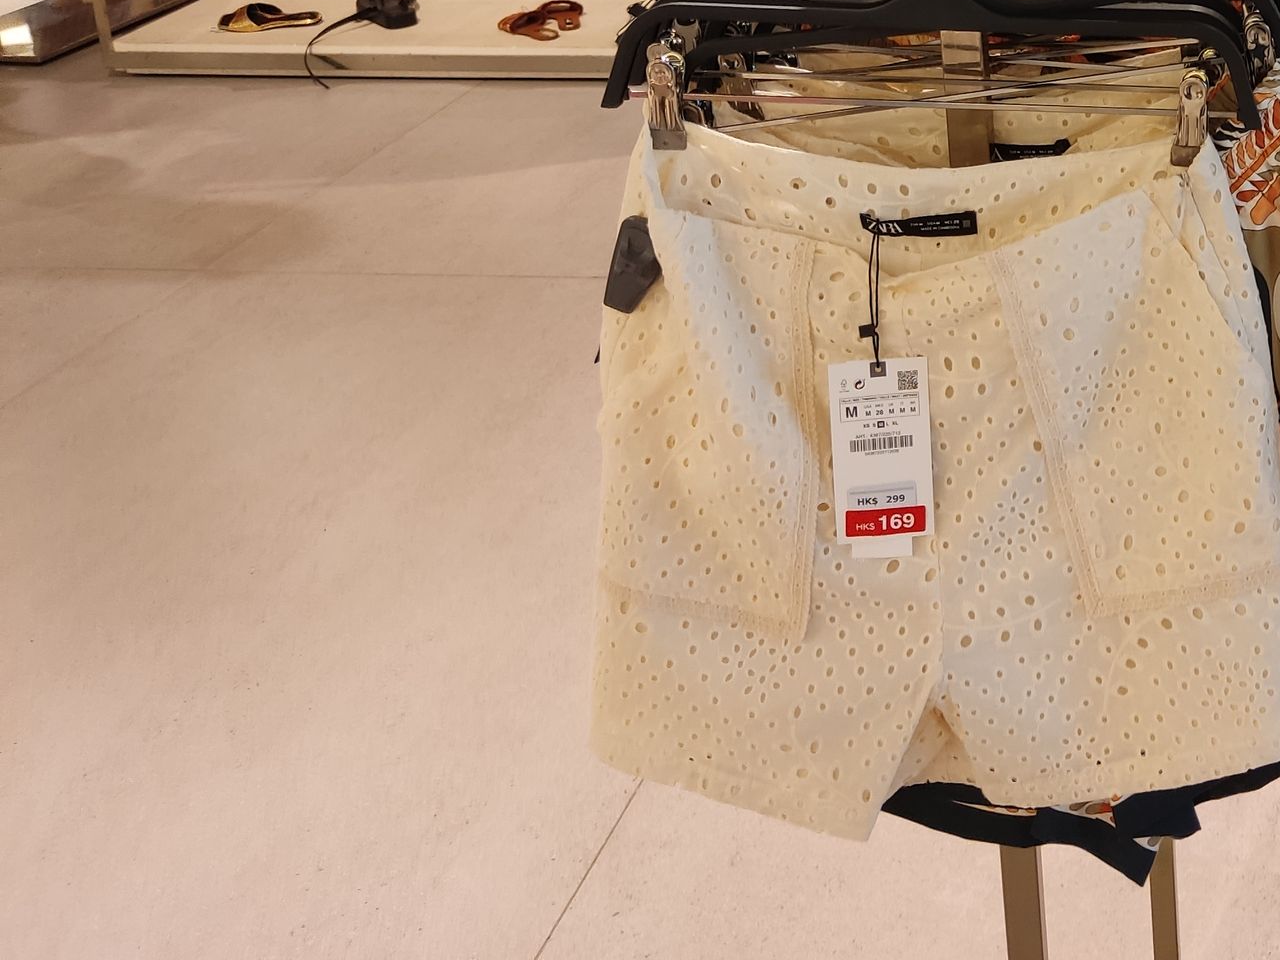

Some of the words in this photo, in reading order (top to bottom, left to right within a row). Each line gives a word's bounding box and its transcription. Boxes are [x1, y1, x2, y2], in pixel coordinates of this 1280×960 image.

[866, 218, 904, 234] ZARA
[845, 406, 858, 419] M
[857, 496, 878, 507] HK$
[886, 494, 906, 504] 299
[855, 522, 875, 531] HK$
[878, 513, 915, 531] 169
